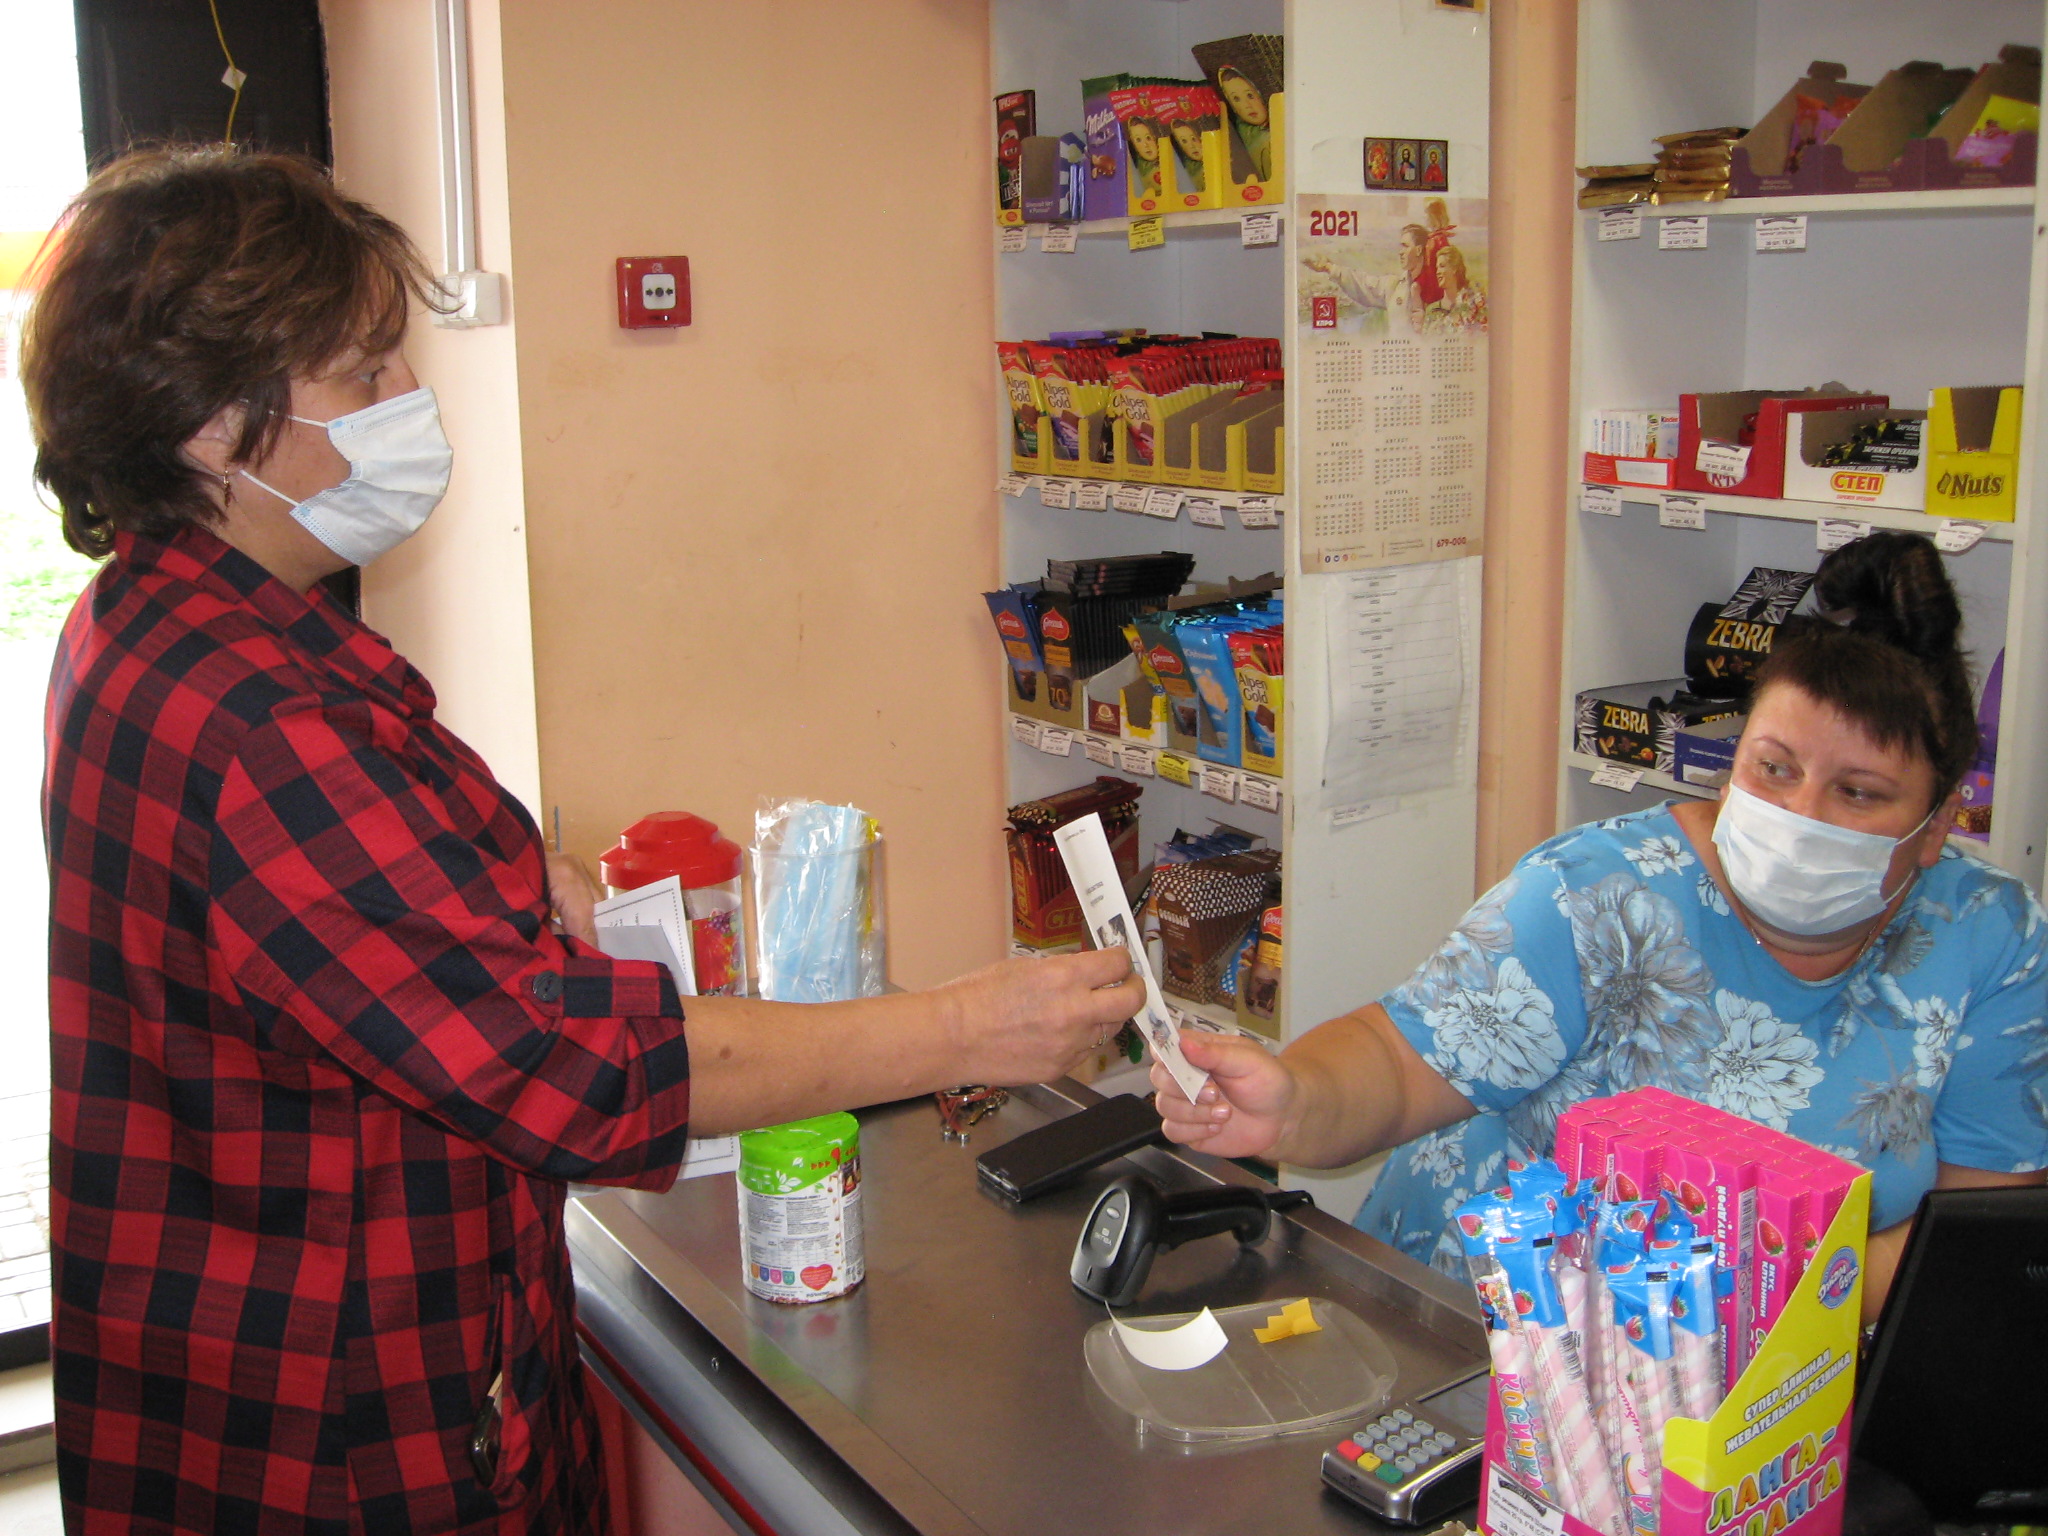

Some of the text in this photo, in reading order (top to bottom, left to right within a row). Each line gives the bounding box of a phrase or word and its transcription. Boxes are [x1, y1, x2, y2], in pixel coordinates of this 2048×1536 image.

[1086, 108, 1116, 136] Milka
[1310, 210, 1358, 236] 2021
[1316, 319, 1335, 327] КПРФ
[1006, 375, 1030, 389] Alpen
[1043, 382, 1070, 396] Alpen
[1010, 390, 1031, 402] Gold
[1048, 396, 1071, 409] Gold
[1119, 393, 1148, 408] Alpen
[1126, 409, 1150, 421] Gold
[1833, 474, 1880, 491] СТЕП
[1949, 473, 2003, 499] Nuts
[1706, 618, 1776, 654] ZEBRA
[1238, 672, 1268, 690] Alpen
[1243, 689, 1268, 704] Gold
[1603, 705, 1649, 735] ZEBRA
[1716, 1185, 1727, 1239] ПУДРОЙ
[1760, 1260, 1768, 1318] КЛУБНИКИ
[1767, 1263, 1776, 1291] ВКУС
[1744, 1347, 1831, 1422] СУПЕР ДЛИННАЯ
[1725, 1350, 1852, 1455] ЖЕВАТЕЛЬНАЯ РЕЗИНКА
[1497, 1373, 1543, 1490] КОСИЧКА
[1720, 1457, 1842, 1536] ЛАНГА
